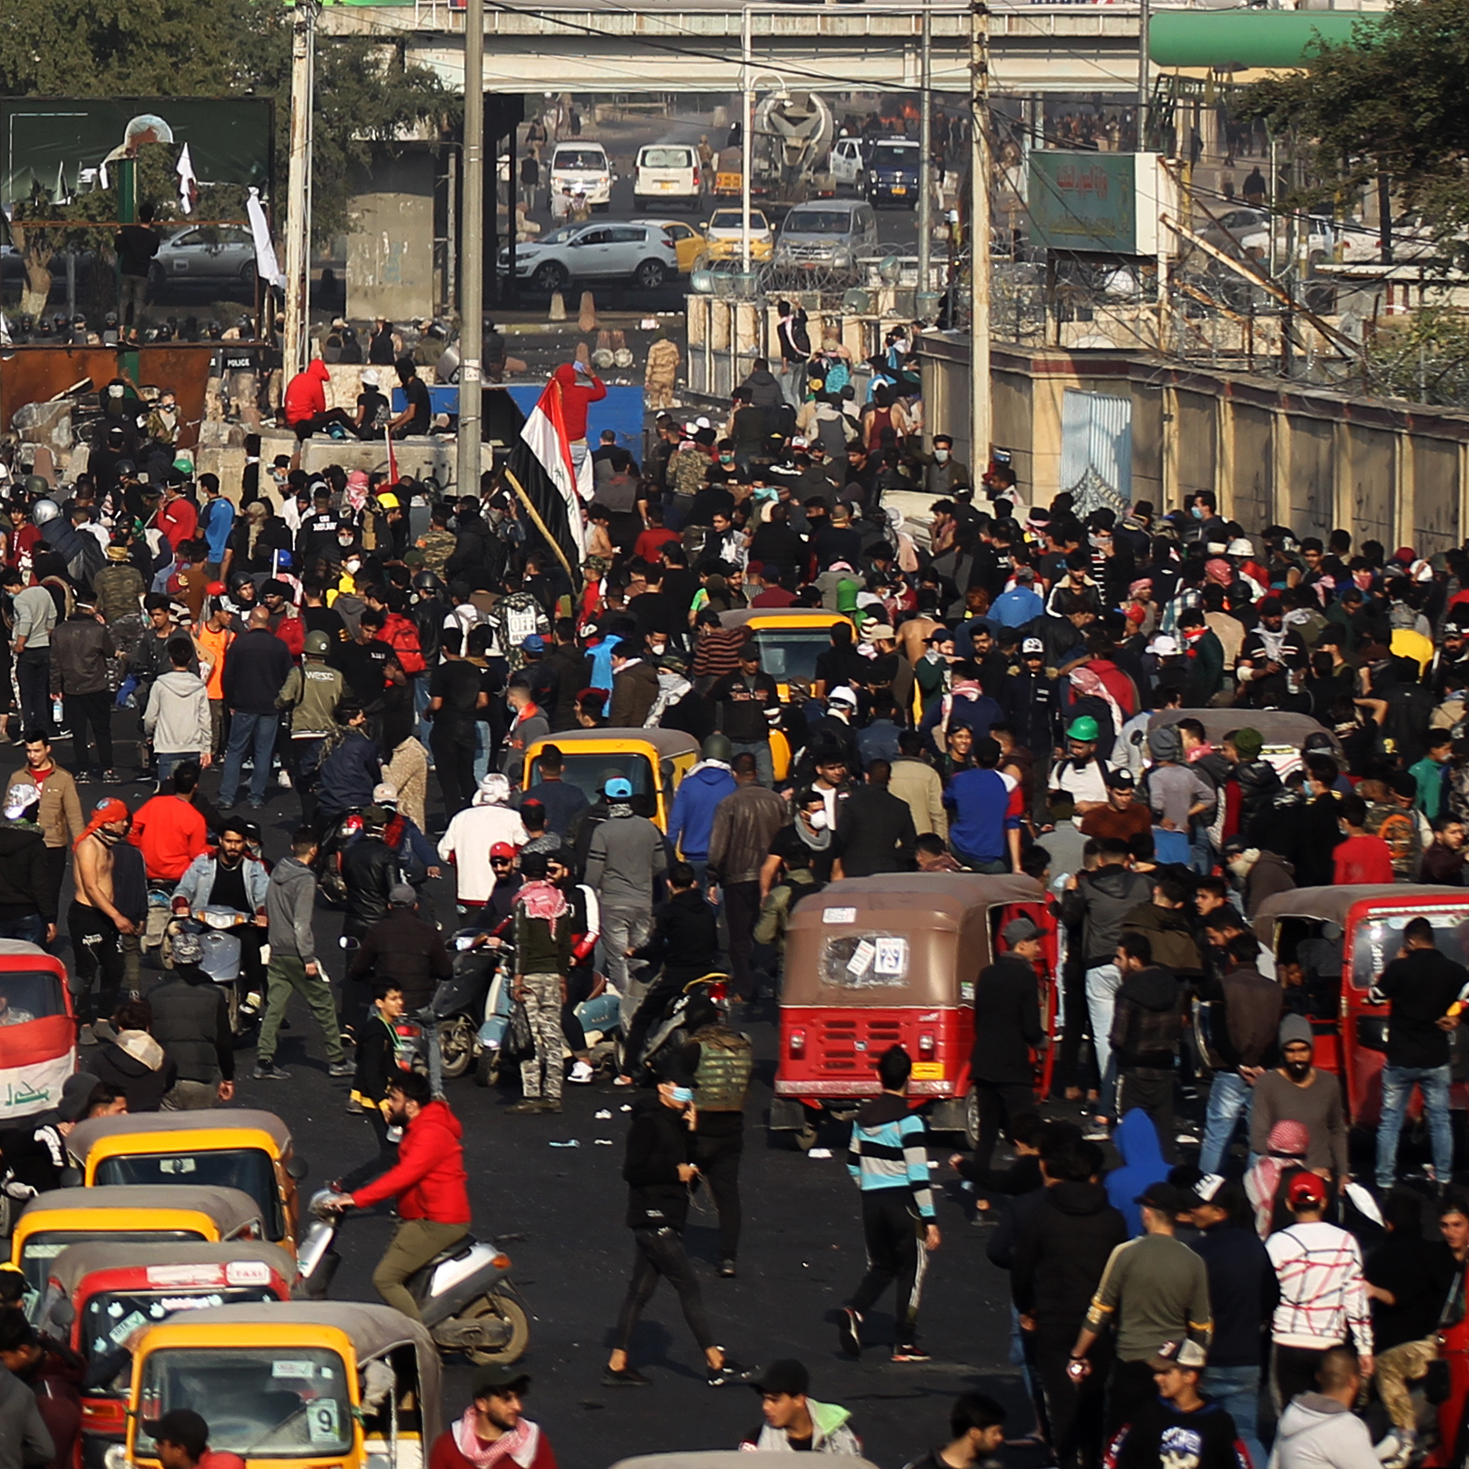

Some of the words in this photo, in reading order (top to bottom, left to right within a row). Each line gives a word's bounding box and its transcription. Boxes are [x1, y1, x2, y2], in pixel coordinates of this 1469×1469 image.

[227, 358, 251, 368] POLICE
[511, 617, 534, 632] OFF
[234, 1269, 264, 1279] TAXI
[316, 1408, 332, 1433] 9
